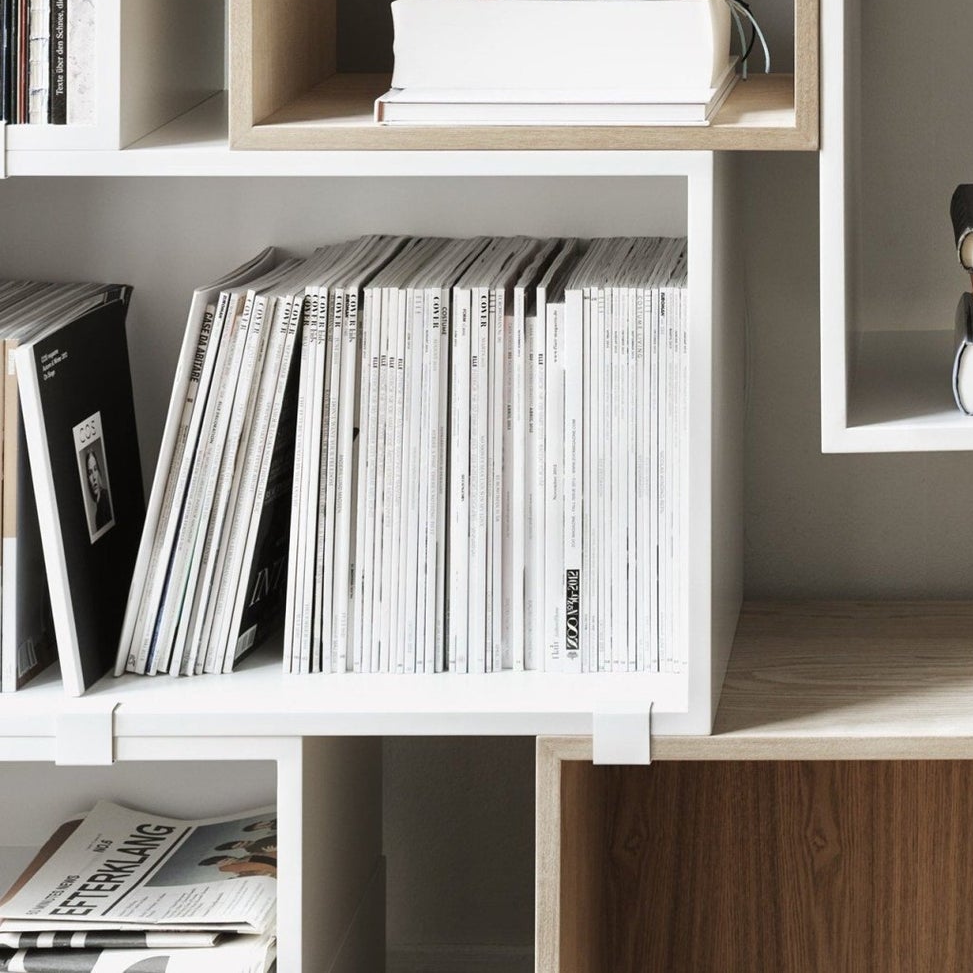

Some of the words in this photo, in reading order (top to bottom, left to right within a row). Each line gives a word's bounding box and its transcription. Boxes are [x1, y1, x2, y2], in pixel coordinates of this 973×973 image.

[201, 312, 214, 333] CASE
[240, 298, 252, 331] COVER
[253, 302, 264, 334] COVER
[280, 302, 292, 334] COVER
[288, 303, 300, 335] COVER
[318, 296, 326, 328] COVER
[350, 294, 358, 326] COVER
[198, 334, 209, 347] DA
[189, 348, 205, 383] ABITARE
[80, 420, 97, 443] COS
[49, 822, 176, 916] EFTERKLANG
